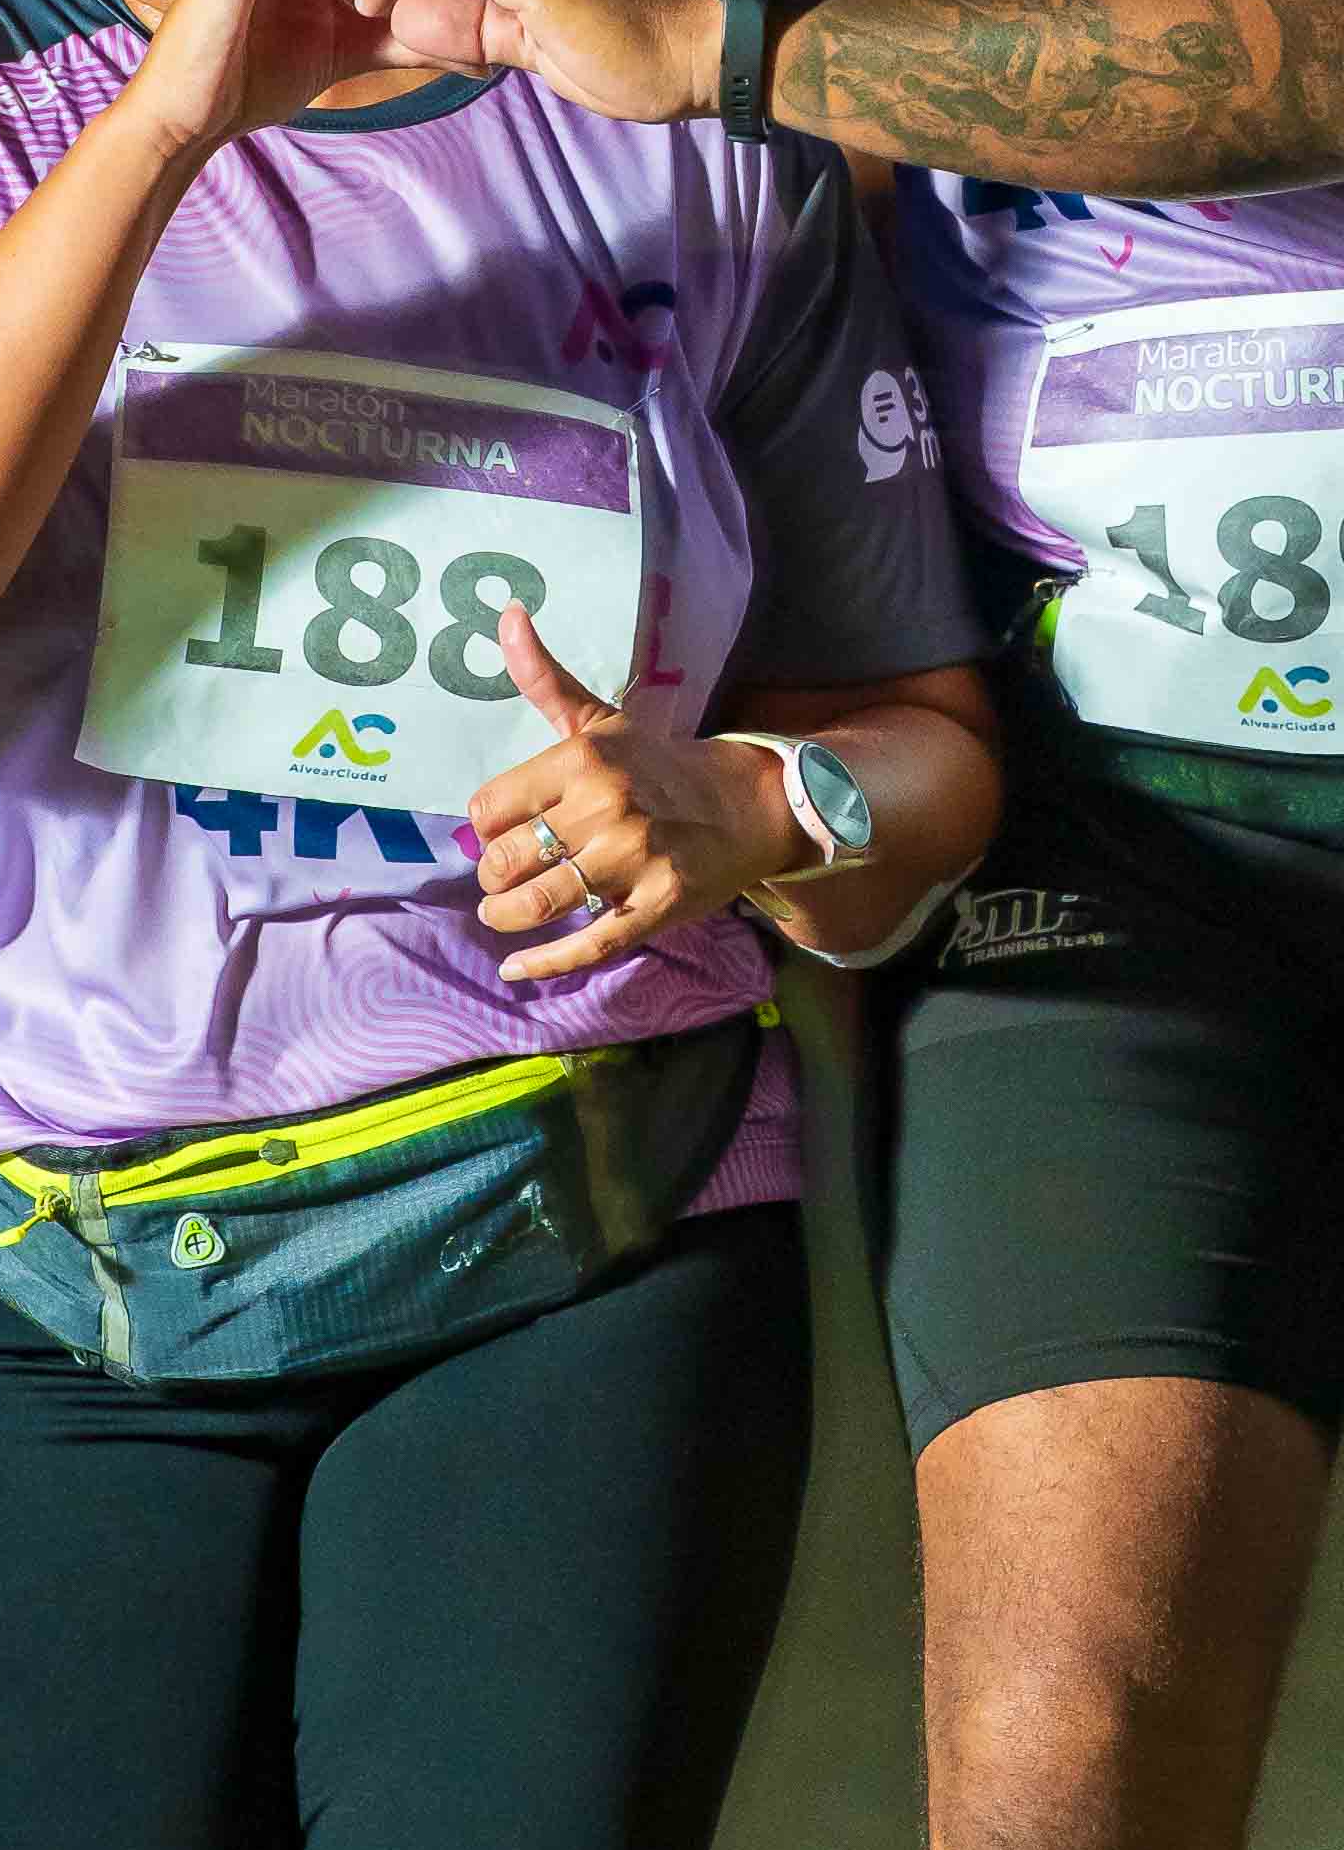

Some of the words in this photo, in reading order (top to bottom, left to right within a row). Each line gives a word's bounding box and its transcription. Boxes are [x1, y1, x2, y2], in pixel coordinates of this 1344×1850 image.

[1135, 331, 1288, 373] Maratón
[243, 376, 407, 423] Maratón
[241, 410, 519, 475] NOCTURNA
[185, 523, 548, 702] 188
[1239, 716, 1338, 733] AlvearCiudad
[288, 762, 389, 784] AlvearCiudad
